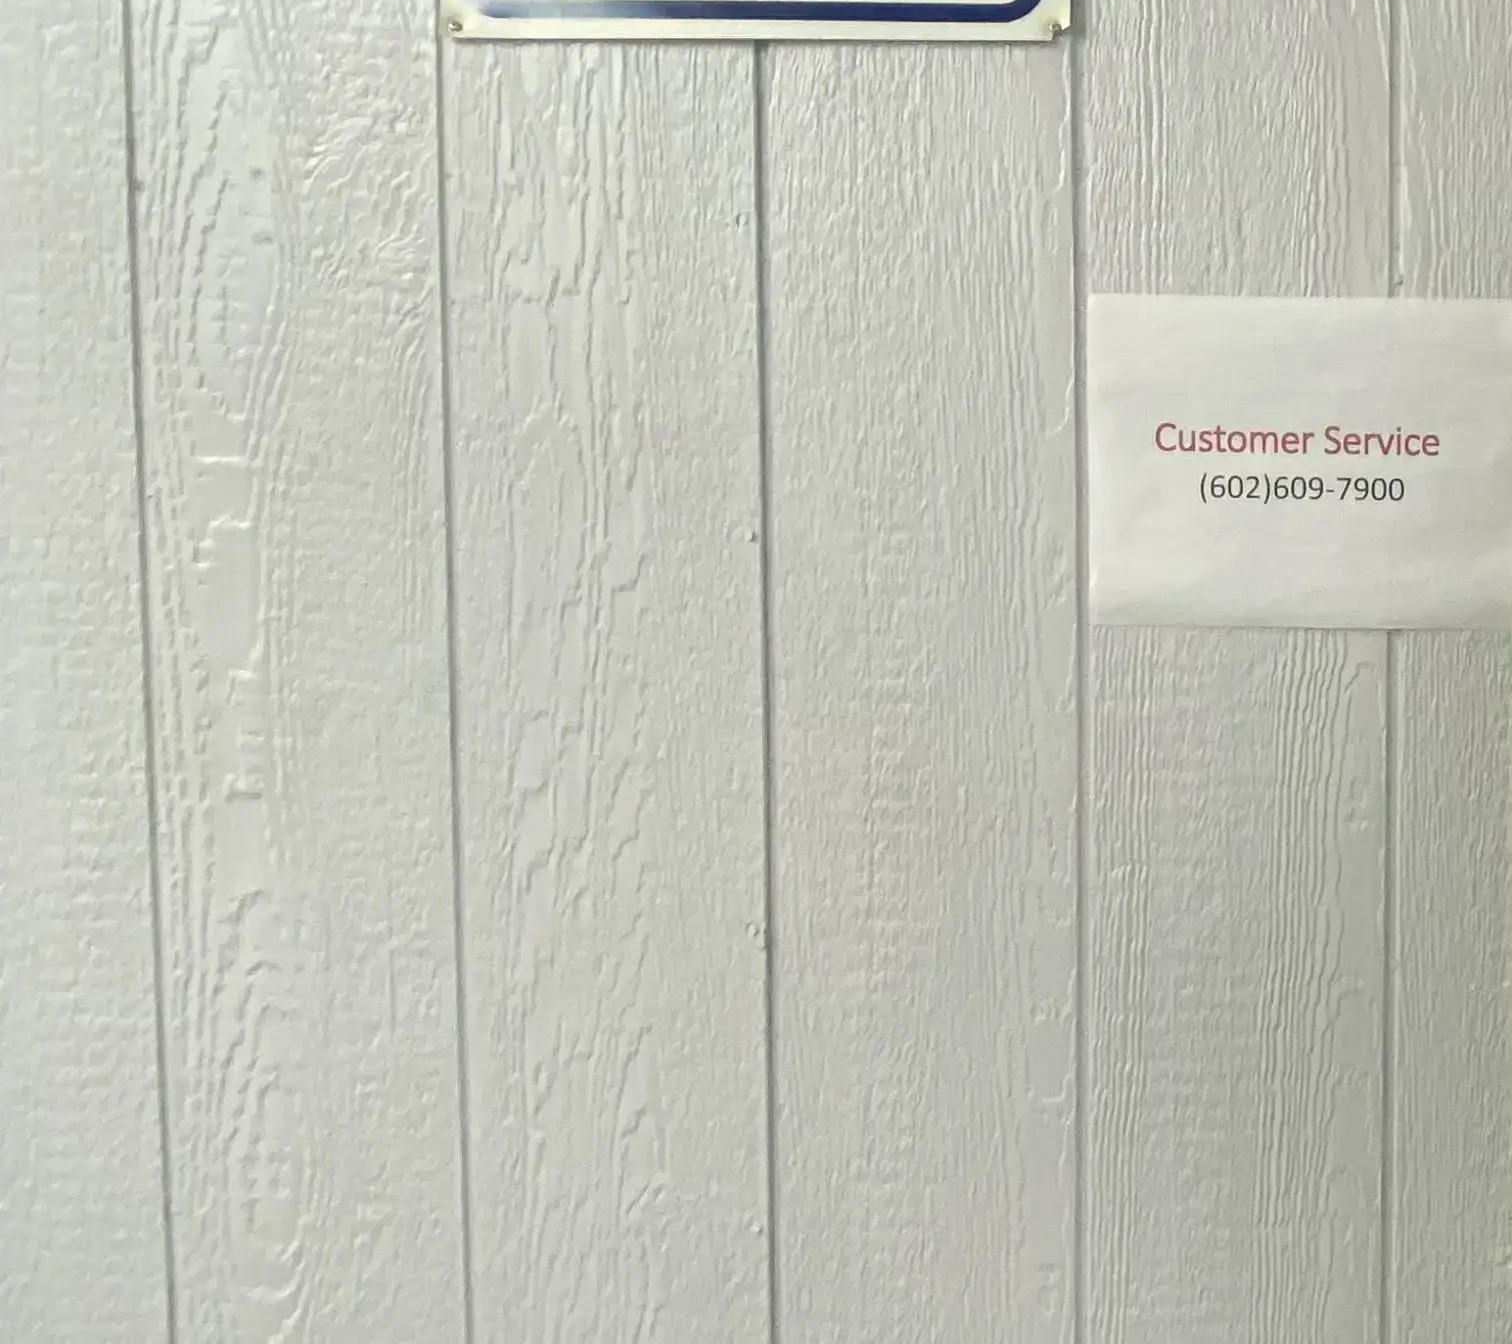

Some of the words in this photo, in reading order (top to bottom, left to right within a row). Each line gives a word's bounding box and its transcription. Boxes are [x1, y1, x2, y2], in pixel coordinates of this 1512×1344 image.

[1154, 421, 1315, 455] Customer
[1323, 425, 1441, 457] Service
[1199, 472, 1406, 504] (602)609-7900
